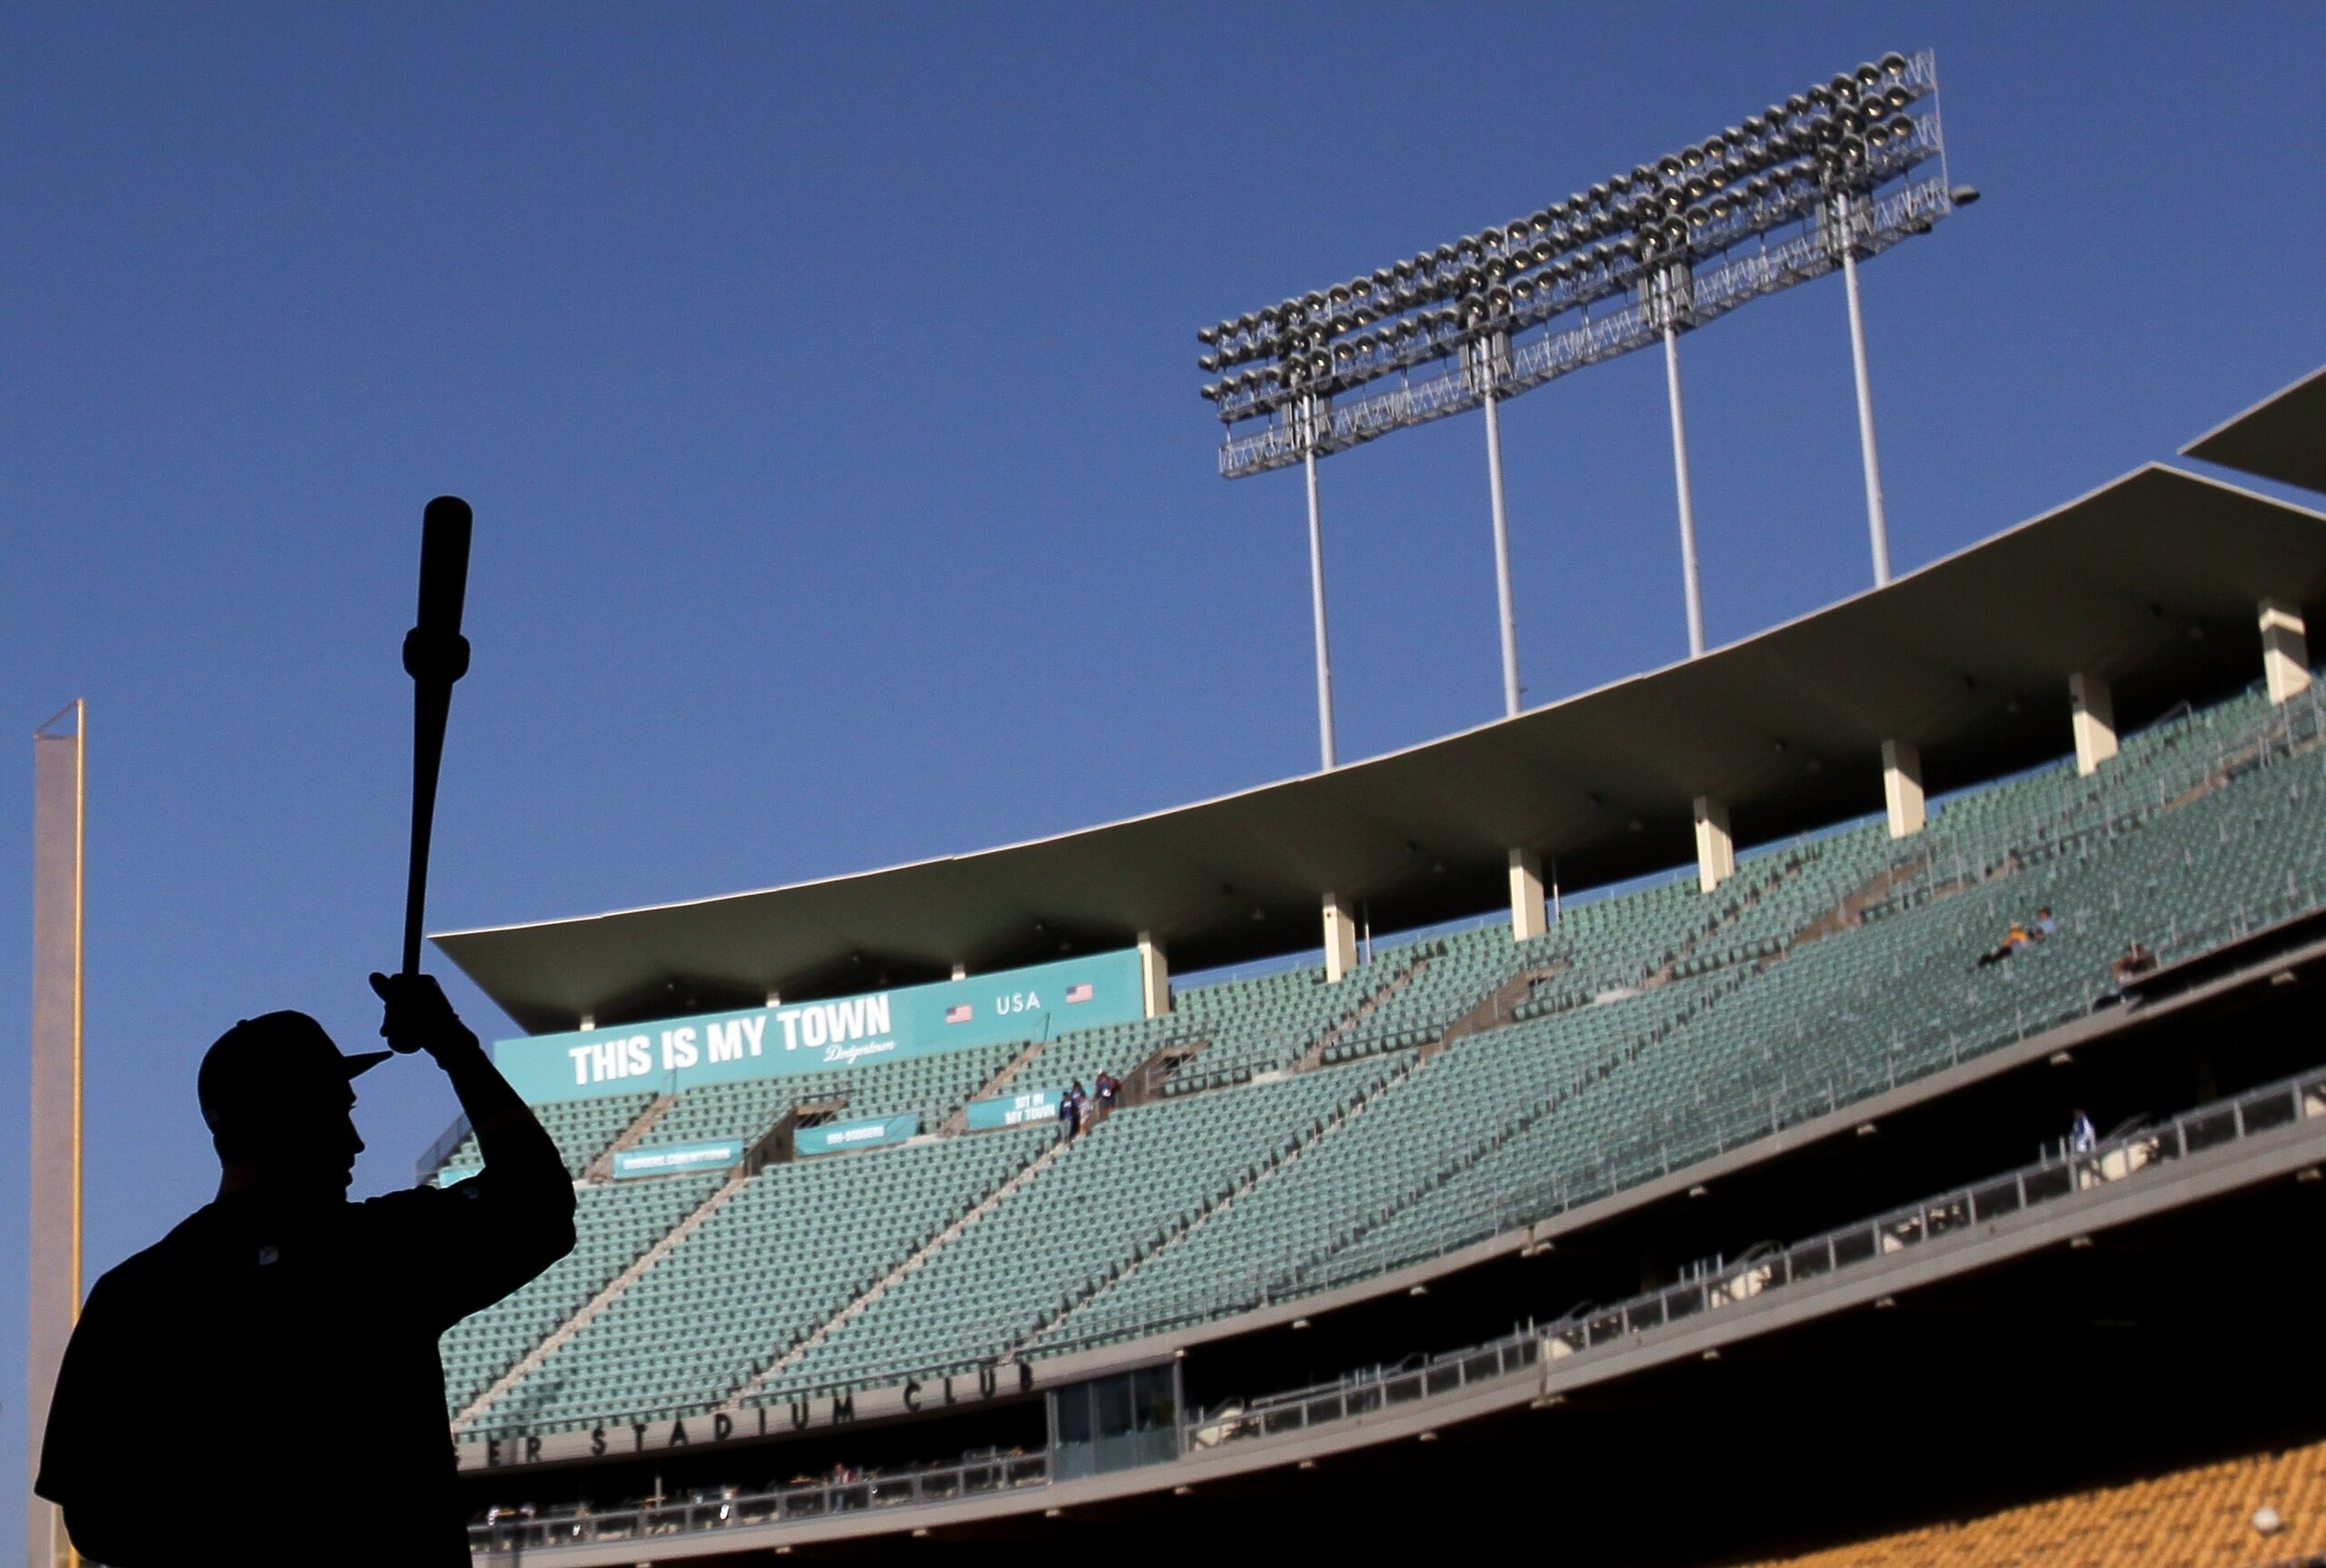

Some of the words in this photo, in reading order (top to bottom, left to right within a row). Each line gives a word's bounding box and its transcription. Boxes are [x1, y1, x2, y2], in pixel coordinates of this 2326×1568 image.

[568, 1035, 652, 1086] THIS
[661, 1027, 700, 1070] IS
[707, 1015, 767, 1065] MY
[777, 994, 891, 1051] TOWN
[996, 990, 1041, 1016] USA
[591, 1393, 855, 1456] STADIUM
[904, 1362, 1034, 1411] CLUB
